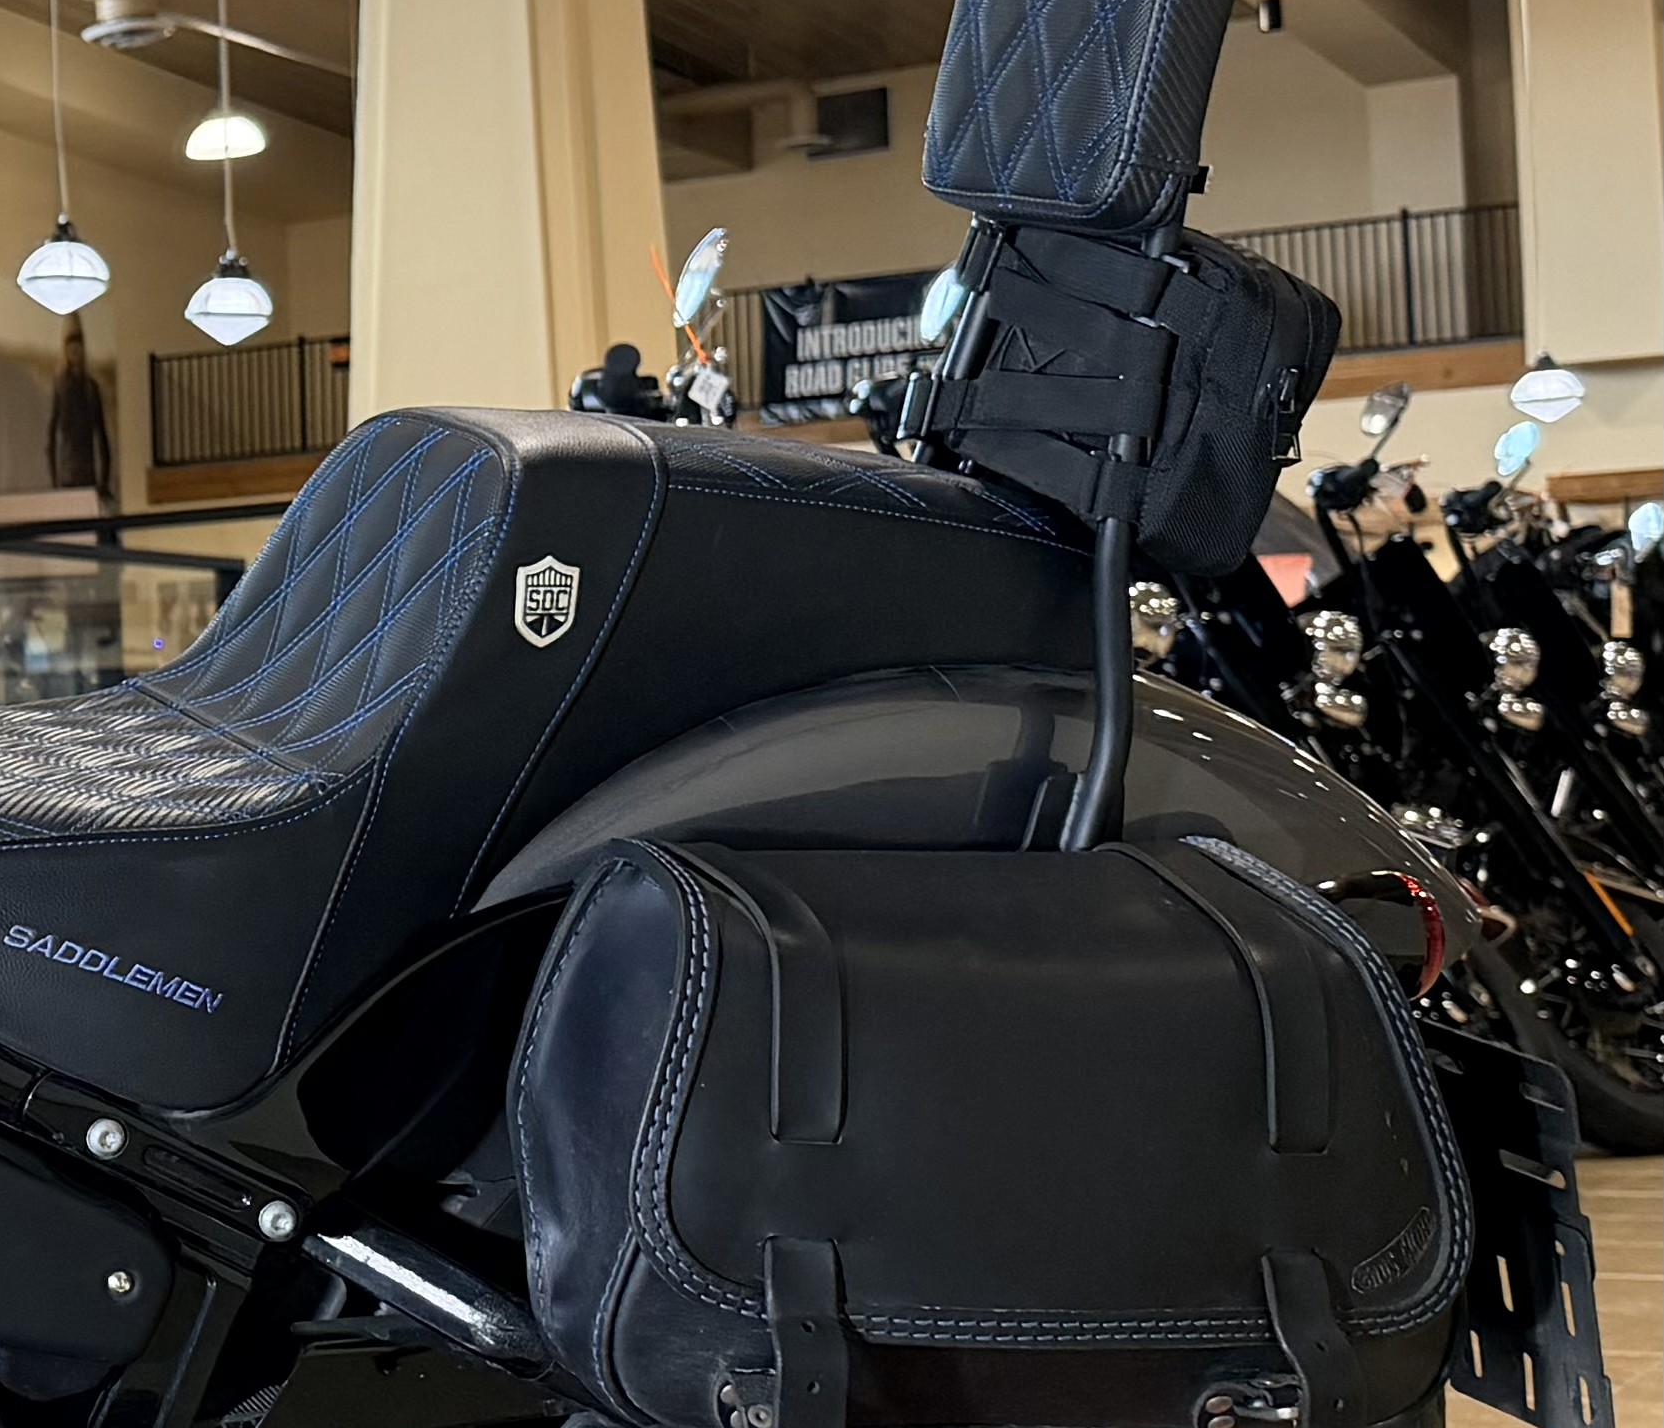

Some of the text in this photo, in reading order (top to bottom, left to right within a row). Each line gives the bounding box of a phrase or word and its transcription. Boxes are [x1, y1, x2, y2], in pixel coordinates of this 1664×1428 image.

[784, 359, 846, 399] ROAD
[527, 589, 568, 612] SDC
[3, 924, 223, 1014] SADDLEMEN
